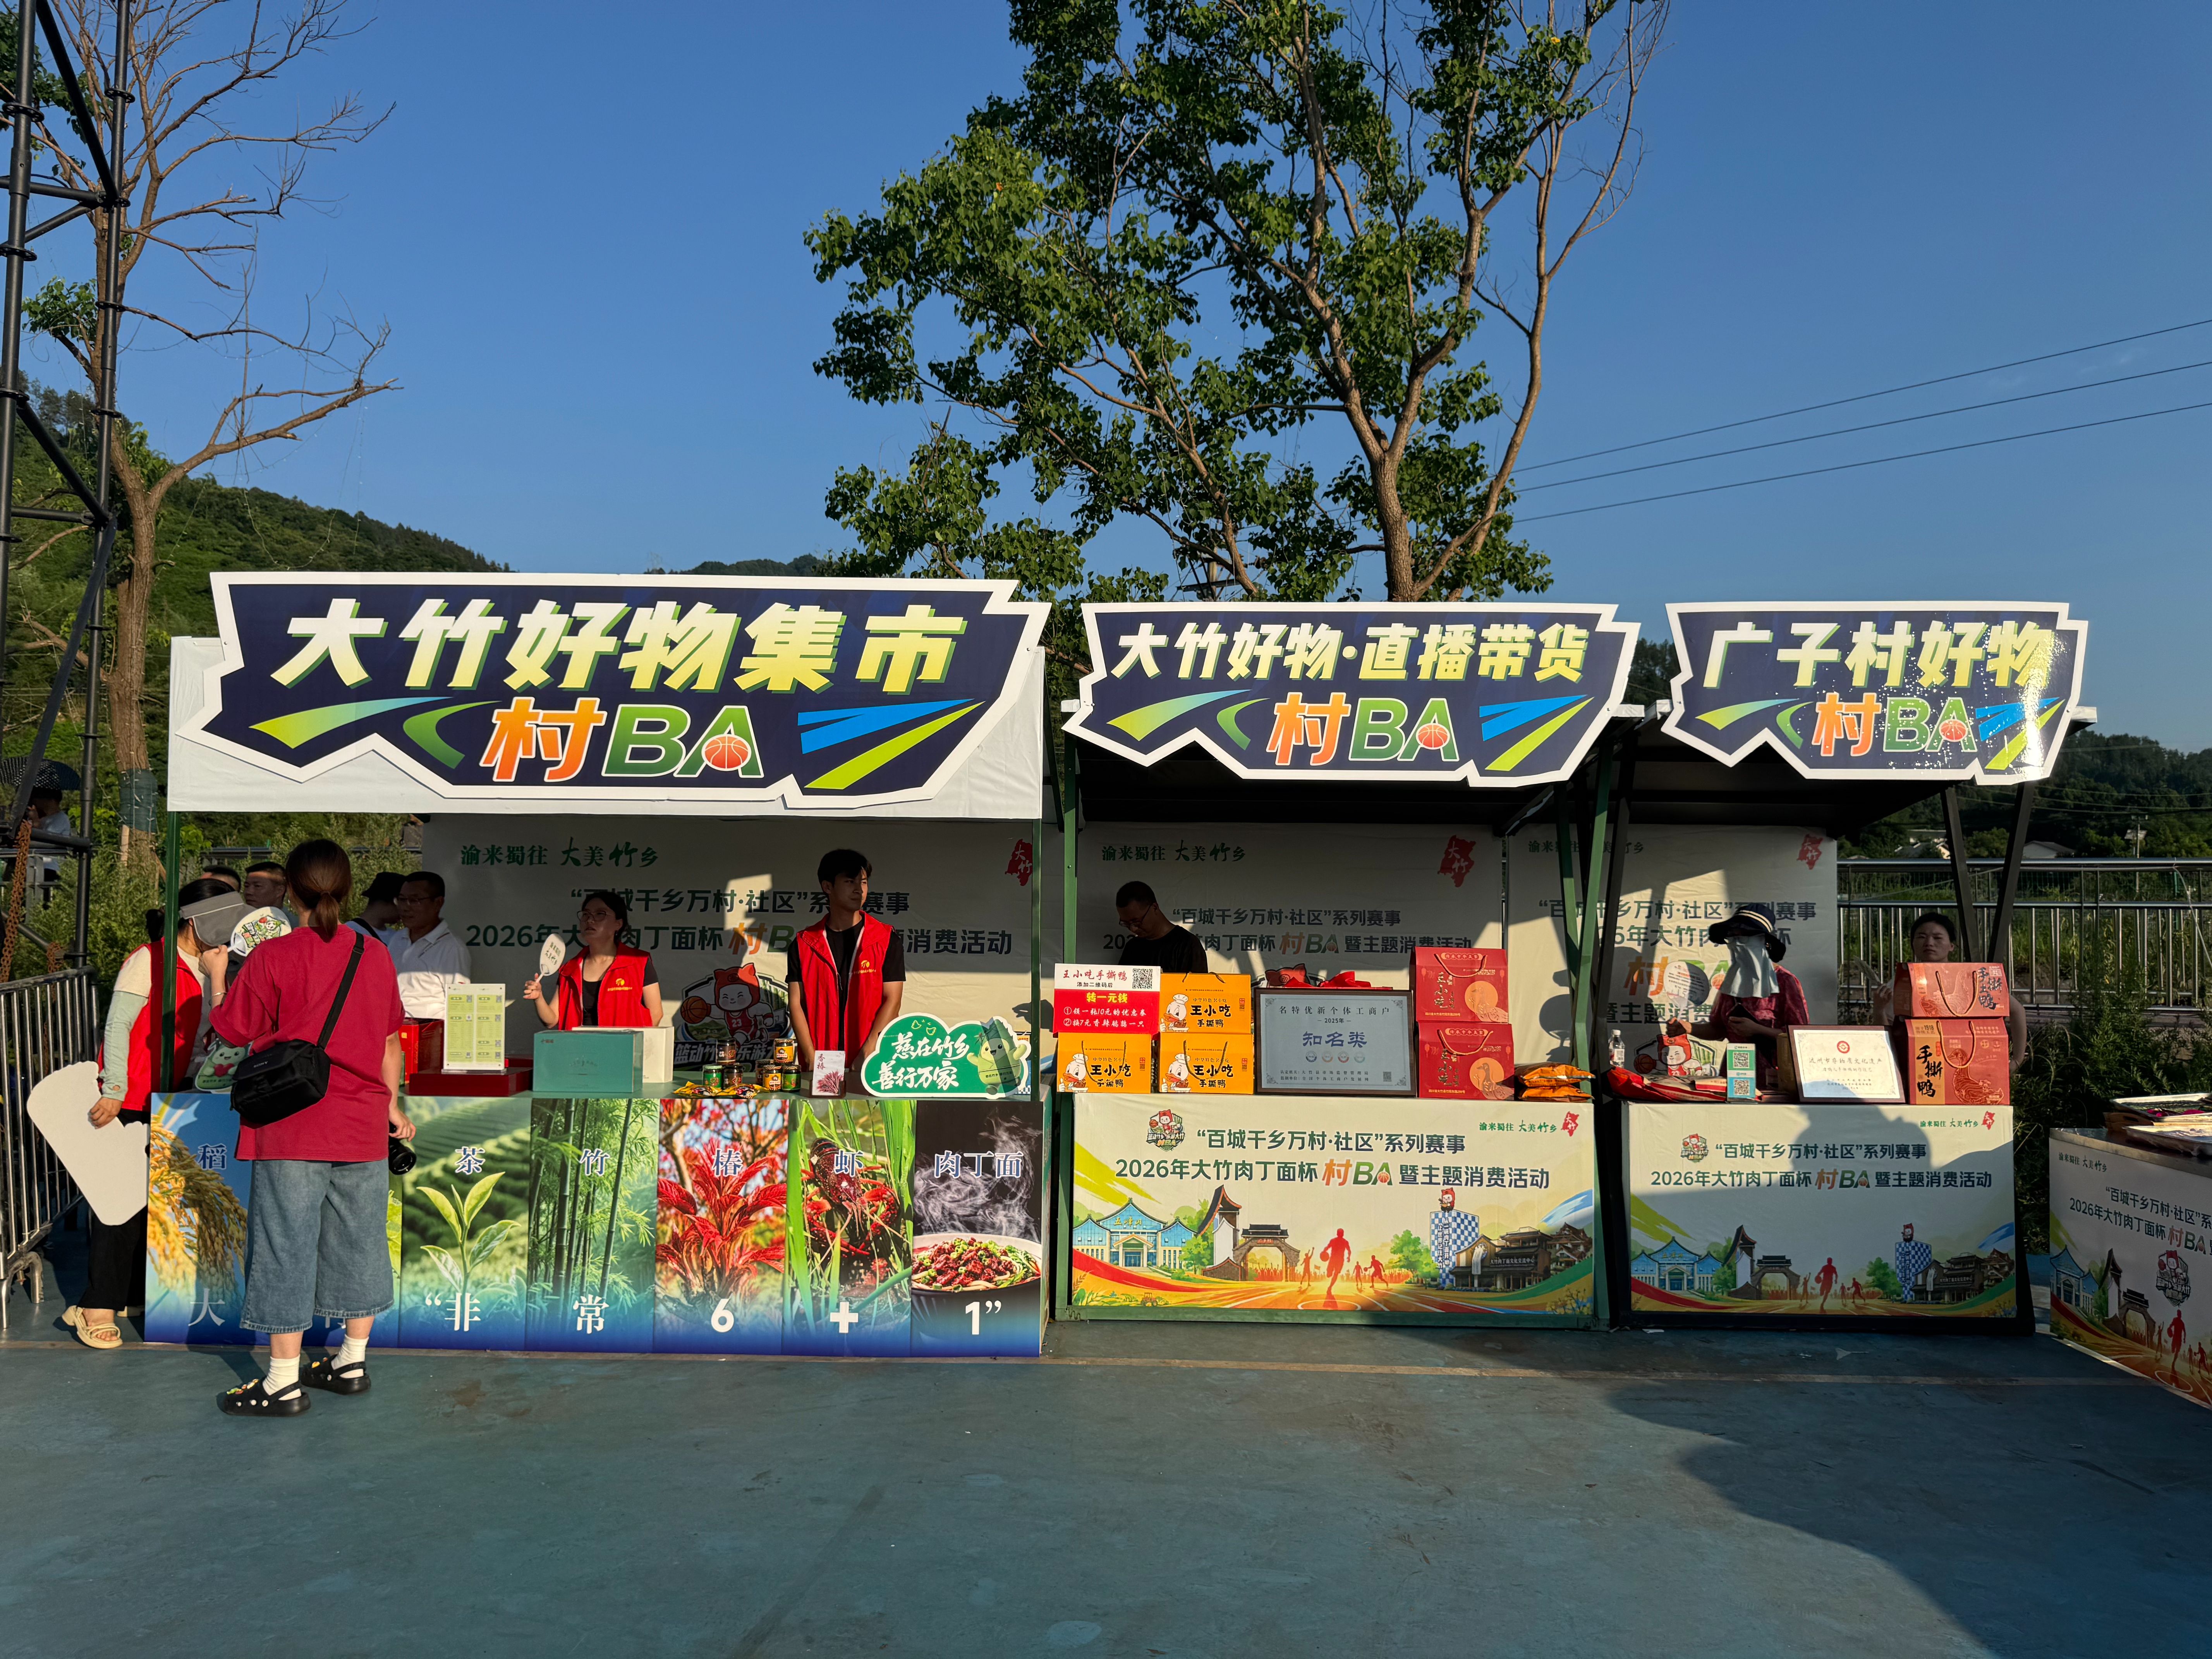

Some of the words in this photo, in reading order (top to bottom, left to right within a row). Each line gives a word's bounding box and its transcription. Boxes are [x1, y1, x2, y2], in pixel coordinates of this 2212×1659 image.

[270, 598, 968, 695] 大竹好物集市
[1111, 622, 1589, 683] 大竹好物·直播带货
[1703, 620, 2056, 689] 广子村好物
[1266, 692, 1460, 766] 村BA
[1812, 692, 1977, 757] 村BA
[479, 697, 764, 782] 村BA
[461, 845, 548, 866] 渝来蜀往
[560, 836, 659, 868] 大美竹乡
[1102, 845, 1166, 861] 渝来蜀往
[1175, 840, 1246, 862] 大美竹乡
[1448, 841, 1468, 873] 大竹
[1528, 840, 1579, 853] 渝来往
[1801, 839, 1818, 860] 大竹
[1015, 846, 1032, 874] 大竹
[466, 924, 723, 950] 2026年大肉丁面杯
[1279, 931, 1339, 955] 村BA
[1063, 969, 1127, 981] 王小吃手撕鸭
[1087, 992, 1128, 1003] 转一元钱
[1190, 1004, 1231, 1017] 王小吃
[1279, 1006, 1389, 1015] 名特优新个体工商户
[1197, 1019, 1224, 1027] 手撕鸭
[891, 1032, 970, 1060] 慈在竹乡
[1303, 1031, 1367, 1048] 知名类
[817, 1053, 825, 1070] 香椿
[1090, 1064, 1131, 1077] 王小吃
[1194, 1064, 1233, 1077] 王小吃
[1917, 1045, 1943, 1097] 手撕鸭
[872, 1060, 959, 1091] 善行万家
[1097, 1079, 1124, 1088] 手撕鸭
[1199, 1079, 1226, 1088] 手撕鸭
[1479, 1122, 1514, 1132] 渝来蜀往
[1518, 1120, 1557, 1133] 大美竹乡
[1565, 1115, 1576, 1131] 大竹
[1197, 1128, 1465, 1154] “百城千乡万村·社区”系列赛事
[198, 1143, 227, 1169] 稻
[455, 1146, 485, 1175] 茶
[580, 1148, 610, 1176] 竹
[711, 1148, 742, 1177] 椿
[833, 1149, 864, 1177] 虾
[934, 1150, 1024, 1178] 肉丁面
[1115, 1159, 1318, 1182] 2026年大竹肉丁面杯
[1322, 1159, 1393, 1186] 村BA
[1399, 1164, 1549, 1189] 暨主题消费活动
[1651, 1170, 1812, 1187] 2026年大竹肉丁面杯
[1815, 1168, 1870, 1190] 村BA
[1875, 1171, 1992, 1188] 暨主题消费活动
[1113, 1216, 1142, 1227] 五峰山
[2069, 1197, 2166, 1240] 2026年大竹肉丁面杯
[2168, 1225, 2206, 1255] 村BA
[188, 1288, 225, 1326] 大
[425, 1292, 481, 1331] “非
[573, 1295, 609, 1334] 常
[711, 1298, 734, 1333] 6
[965, 1300, 1001, 1335] 1”
